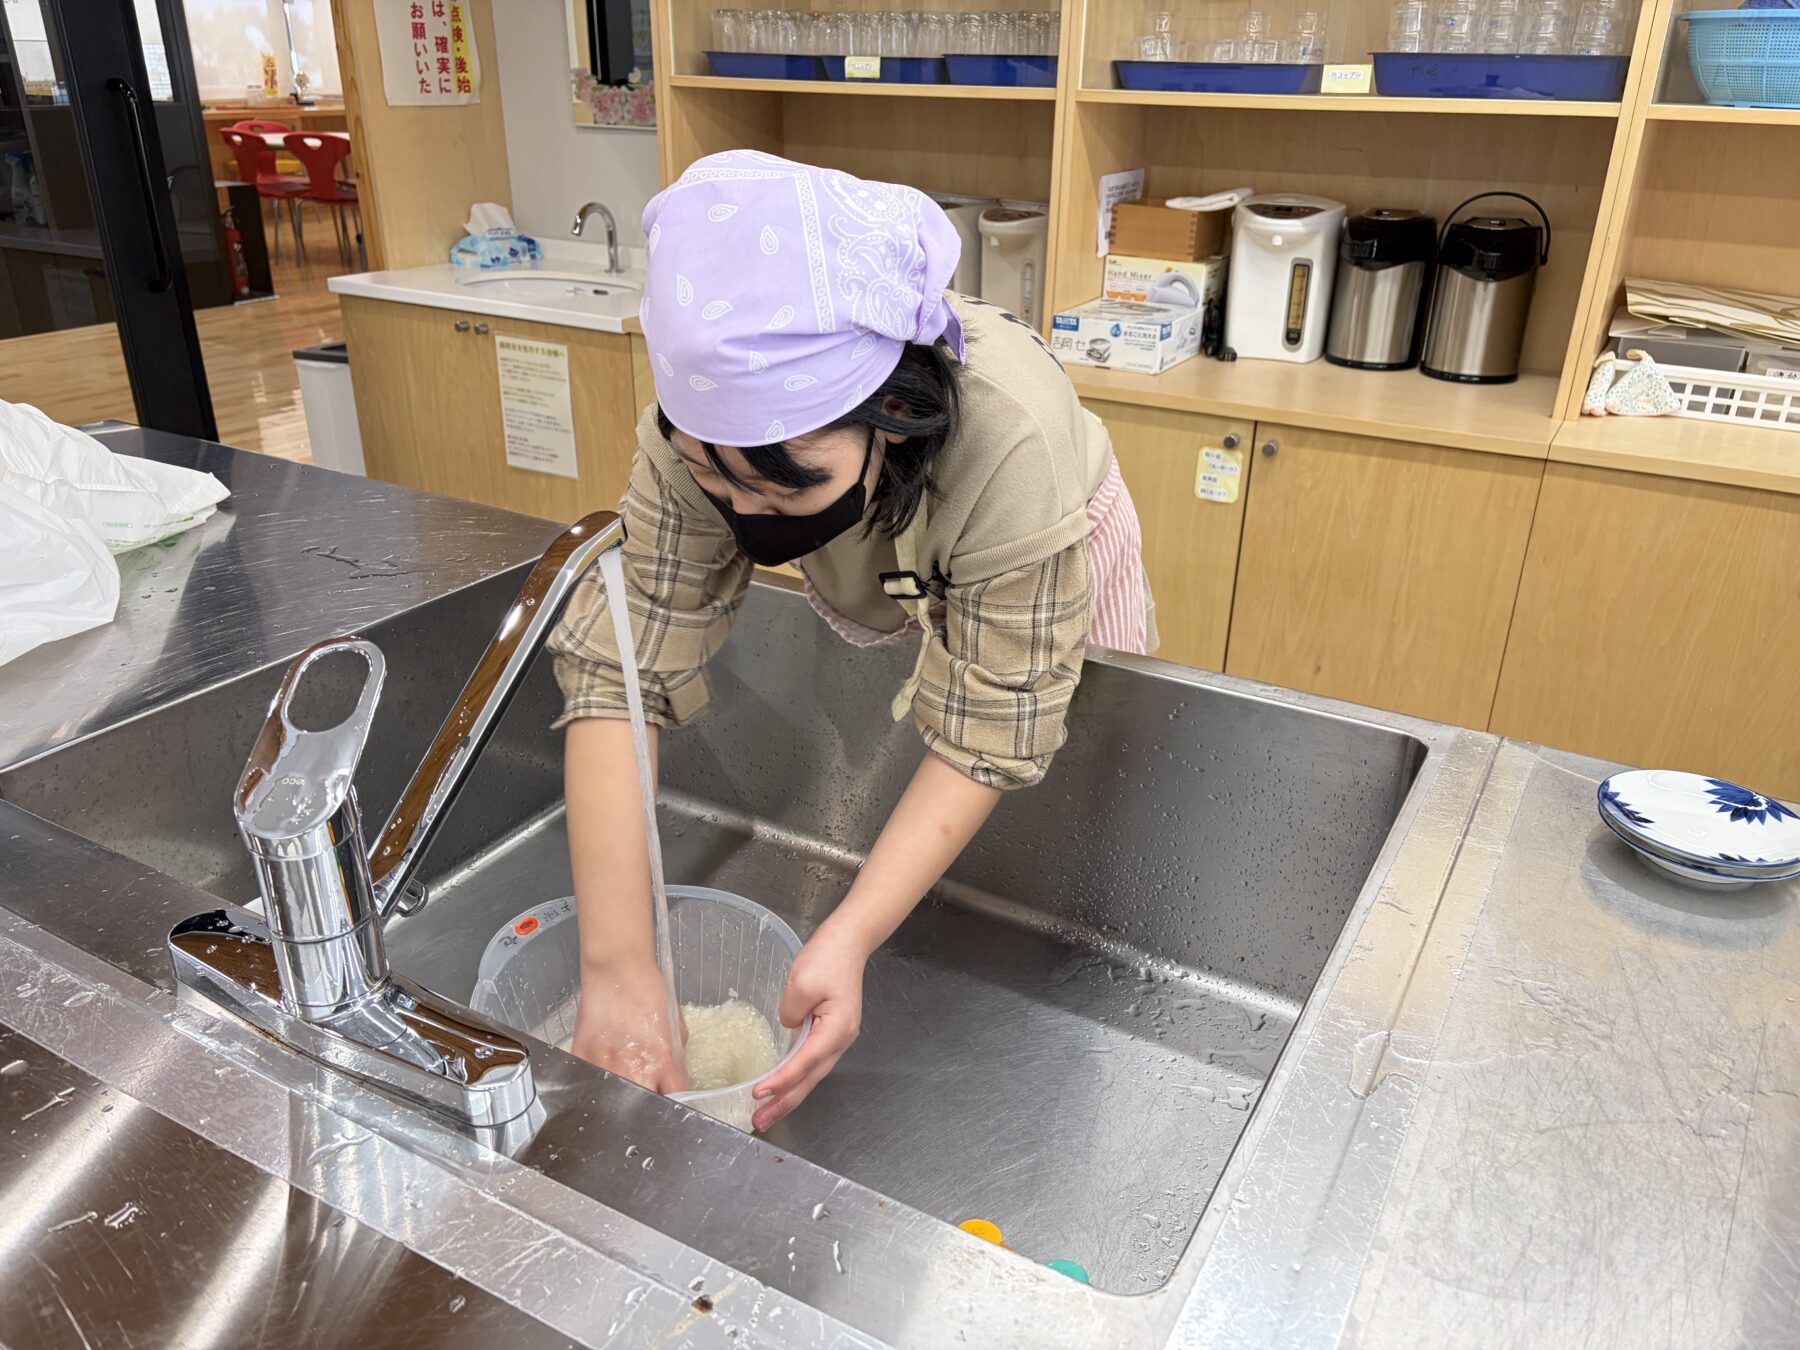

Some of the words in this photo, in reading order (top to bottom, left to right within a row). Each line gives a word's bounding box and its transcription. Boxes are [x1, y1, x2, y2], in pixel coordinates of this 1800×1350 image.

[410, 2, 432, 94] お願いいた
[450, 0, 472, 95] 点検・後始
